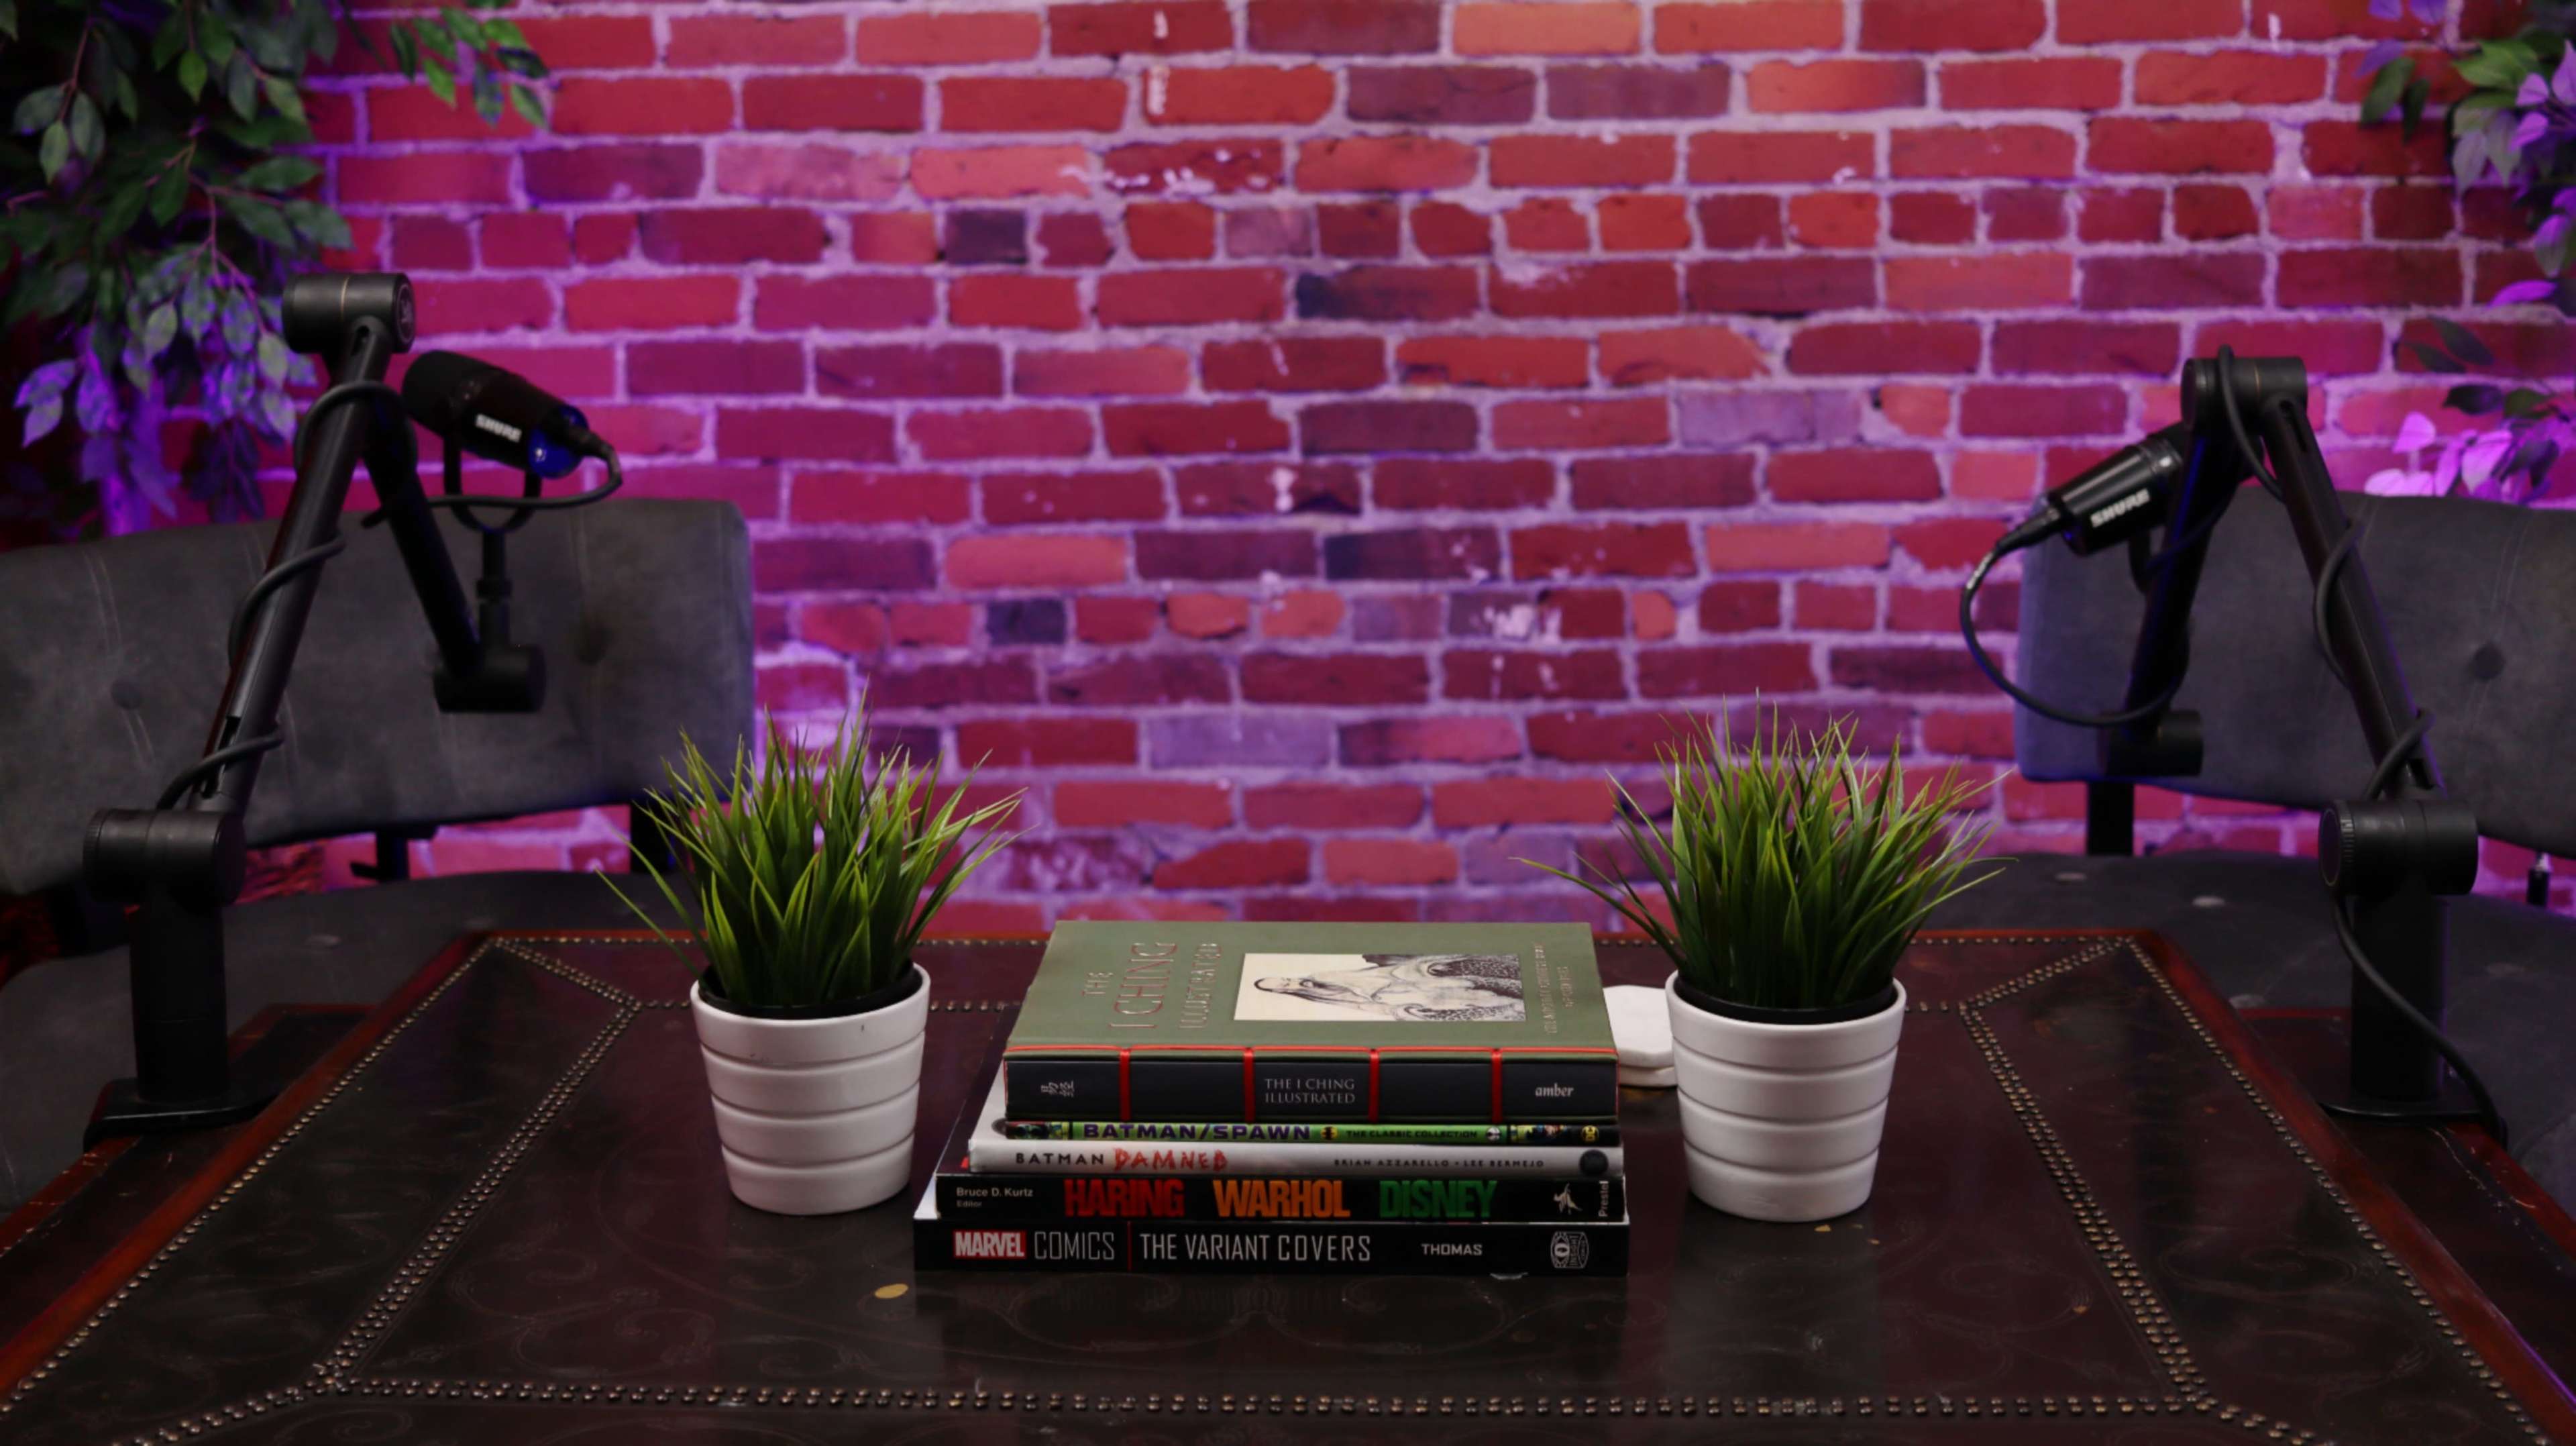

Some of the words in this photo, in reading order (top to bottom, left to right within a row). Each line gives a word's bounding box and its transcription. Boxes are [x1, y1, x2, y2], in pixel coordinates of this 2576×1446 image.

[476, 413, 522, 443] SHURE
[2090, 488, 2150, 528] SHURE
[1081, 972, 1114, 996] THE
[1114, 942, 1178, 1015] CHING
[1179, 943, 1222, 1029] ILLUSTRATED
[1264, 1078, 1291, 1090] THE
[1305, 1078, 1356, 1090] CHING
[1535, 1082, 1574, 1097] amber
[1265, 1092, 1356, 1104] ILLUSTRATED
[1083, 1124, 1311, 1139] BATMAN/SPAWN
[1346, 1130, 1366, 1138] THE
[1369, 1130, 1412, 1139] CLASSIC
[1415, 1130, 1477, 1139] COLLECTION
[1016, 1153, 1104, 1166] BATMAN
[1112, 1148, 1228, 1172] DAMNED
[1334, 1159, 1371, 1167] BRIAN
[1377, 1159, 1450, 1167] AZZARELLO
[1490, 1159, 1545, 1168] BERMEJO
[956, 1187, 989, 1196] Bruce
[991, 1187, 1002, 1196] D.
[1004, 1187, 1034, 1196] Kurtz
[1063, 1178, 1185, 1218] HARING
[1212, 1178, 1351, 1219] WARHOL
[1379, 1179, 1497, 1219] DISNEY
[1598, 1180, 1609, 1217] Prestel
[956, 1200, 982, 1208] Editor
[955, 1231, 1026, 1257] MARVEL
[1034, 1231, 1115, 1260] COMICS
[1140, 1233, 1177, 1260] THE
[1185, 1234, 1270, 1261] VARIANT
[1277, 1235, 1371, 1262] COVERS
[1421, 1243, 1483, 1256] THOMAS
